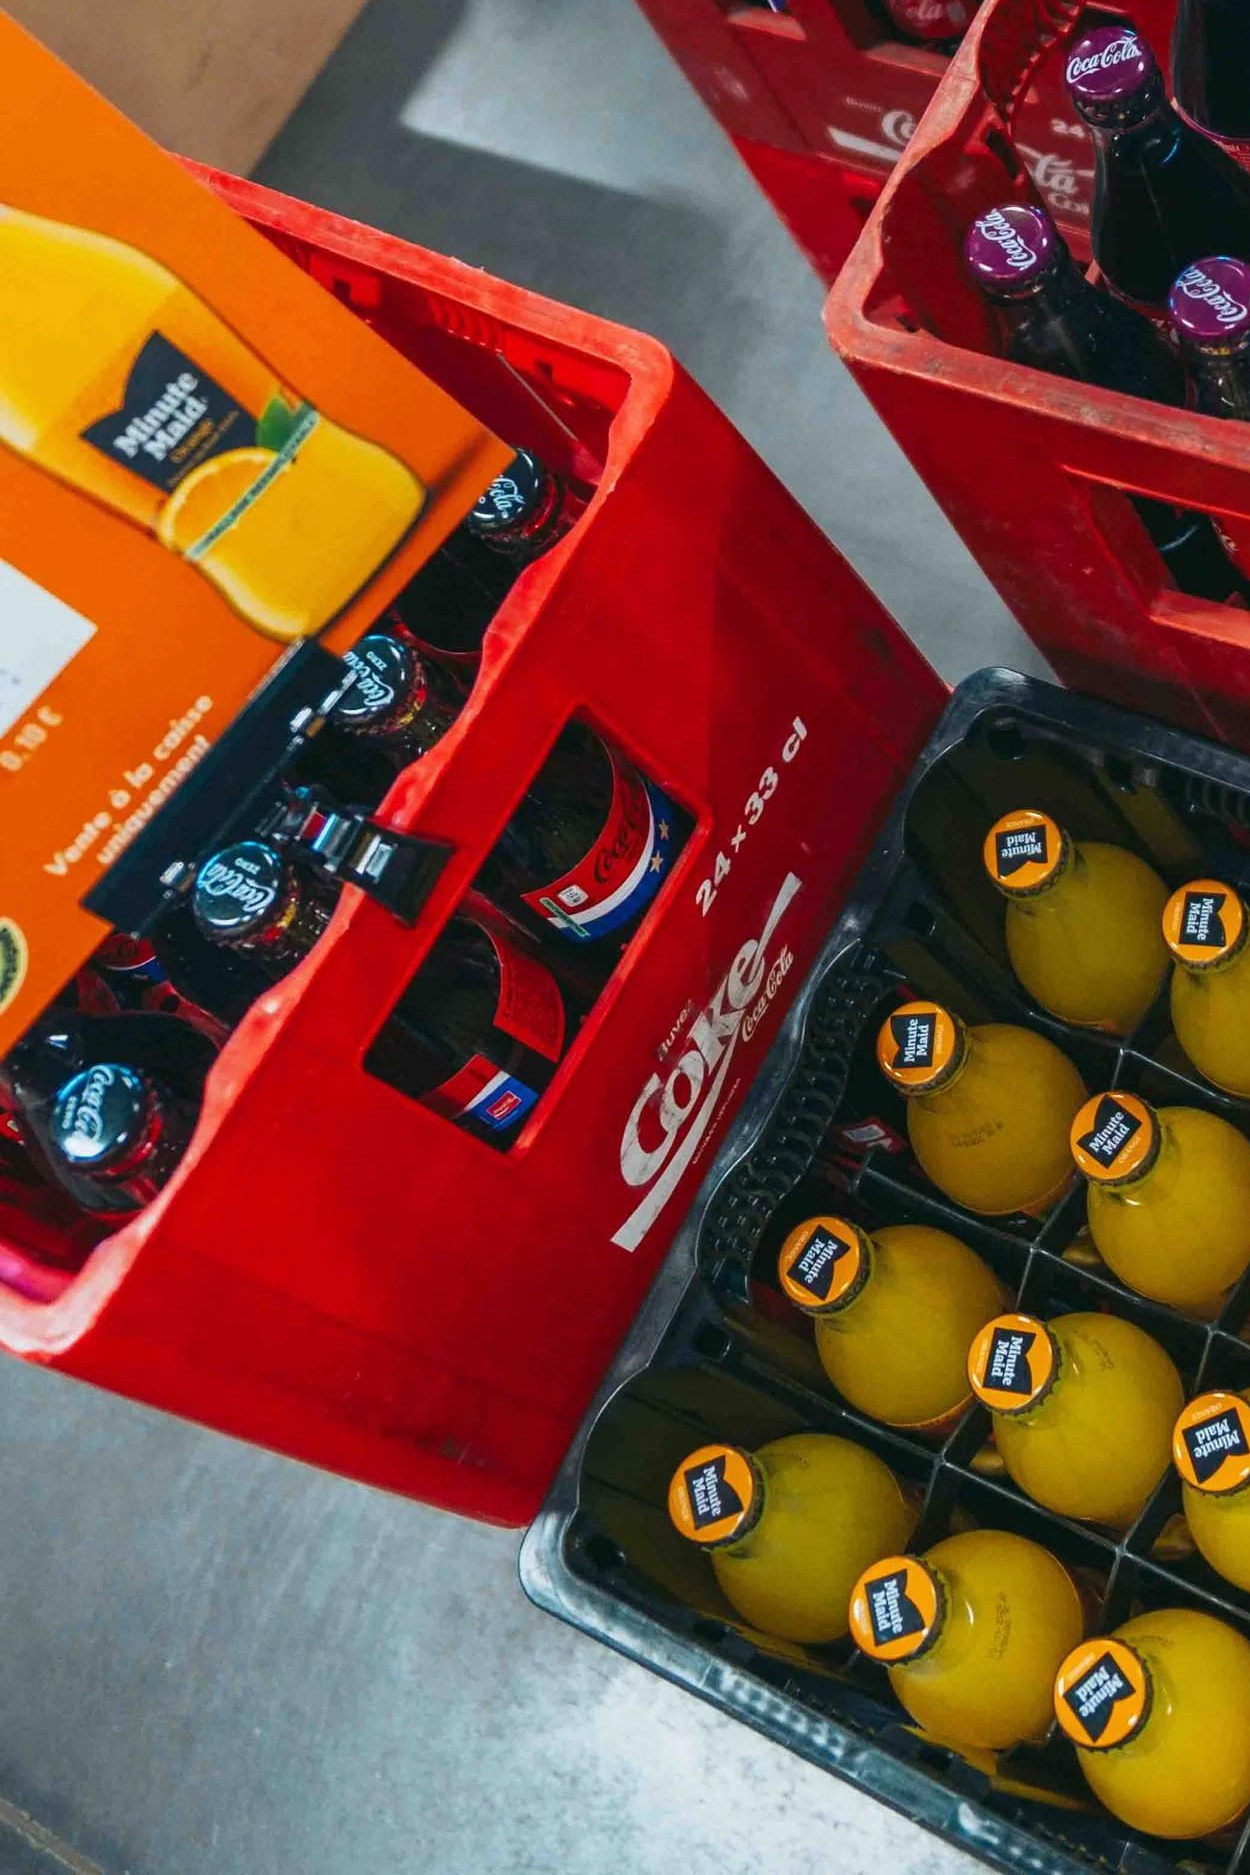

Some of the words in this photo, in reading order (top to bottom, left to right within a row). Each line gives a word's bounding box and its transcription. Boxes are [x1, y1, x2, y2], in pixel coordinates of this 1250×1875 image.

[1065, 36, 1143, 84] Coca-Cola
[113, 372, 198, 459] Minute
[143, 398, 208, 462] Maid
[364, 647, 387, 672] ZERO
[43, 811, 112, 876] Vente
[108, 788, 131, 810] à
[123, 762, 155, 789] la
[153, 694, 213, 761] caisse
[97, 734, 211, 865] uniquement
[695, 848, 734, 918] 24
[743, 766, 780, 821] 33
[781, 715, 808, 764] cl
[1005, 830, 1036, 847] Maid
[234, 856, 263, 875] ZERO
[1001, 840, 1044, 860] Minute
[740, 943, 793, 1043] Coca-Cola
[619, 871, 802, 1188] Coke
[903, 1017, 919, 1065] Minute
[915, 1023, 930, 1062] Maid
[1089, 1109, 1127, 1153] Minute
[1101, 1123, 1130, 1156] Maid
[798, 1235, 826, 1272] Maid
[803, 1239, 839, 1285] Minute
[990, 1339, 1008, 1378] Maid
[1001, 1335, 1025, 1387] Minute
[692, 1476, 709, 1516] Maid
[703, 1465, 722, 1517] Minute
